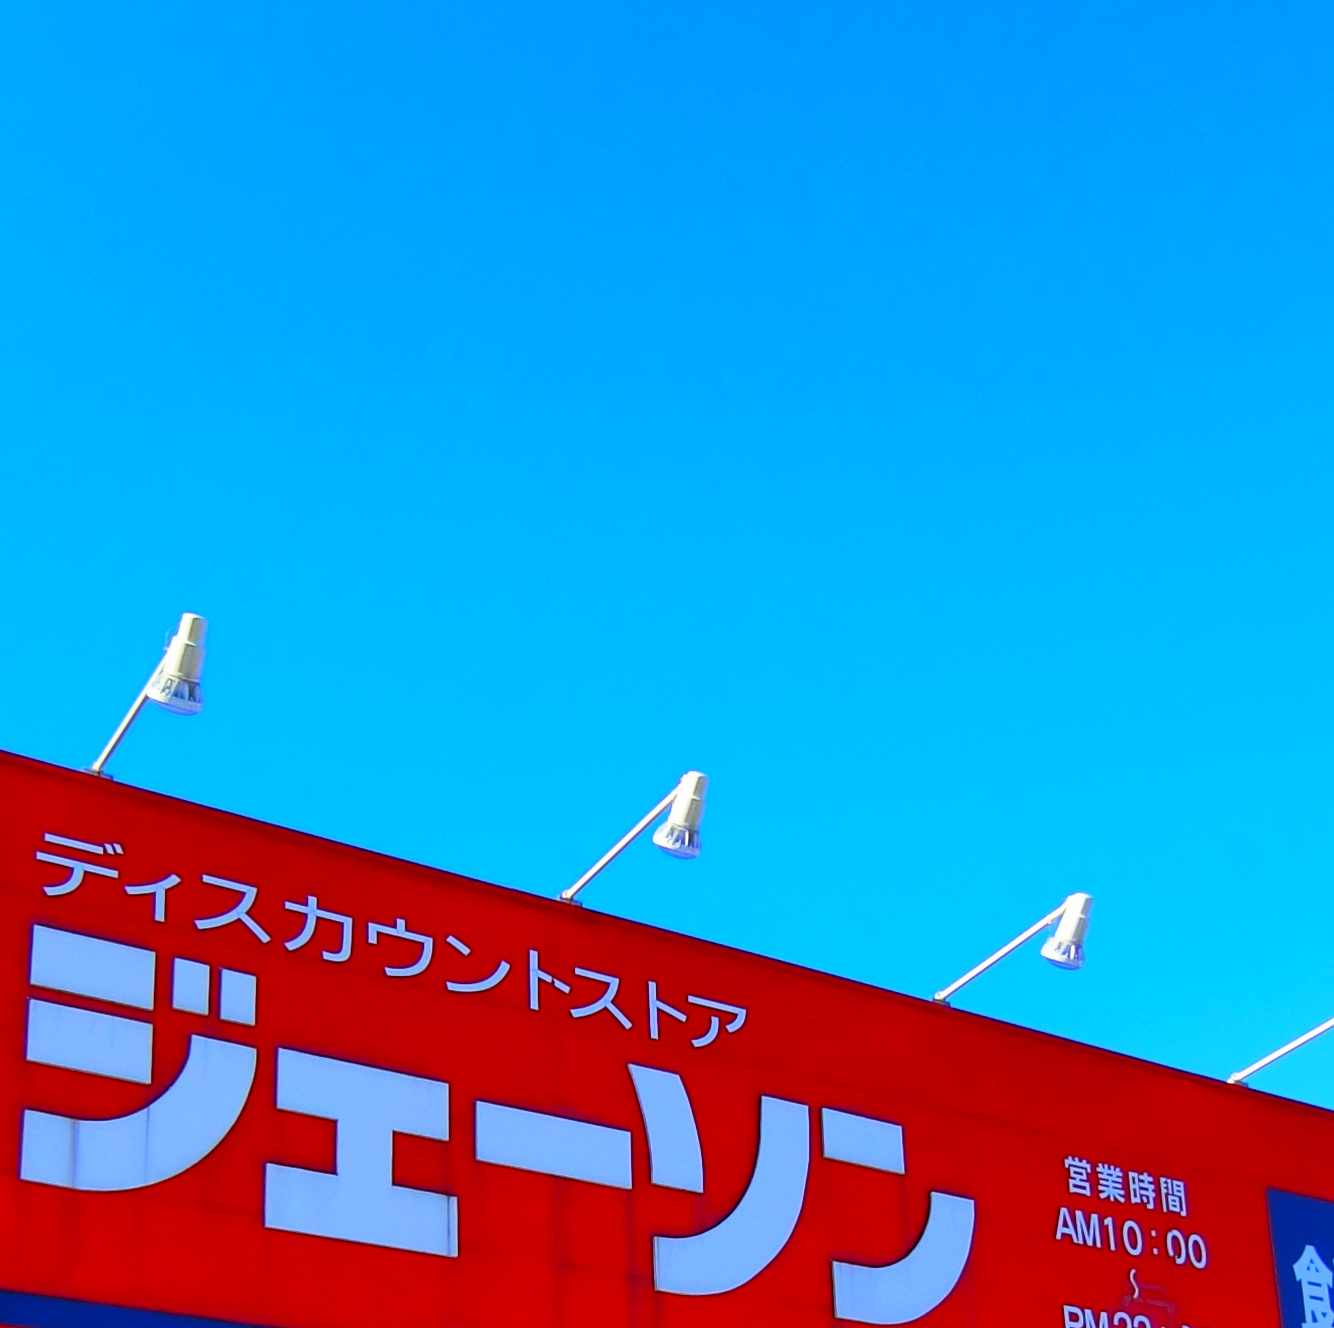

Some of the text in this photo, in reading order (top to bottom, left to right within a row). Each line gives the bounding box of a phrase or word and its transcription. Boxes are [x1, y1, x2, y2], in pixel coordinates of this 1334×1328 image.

[36, 832, 748, 1049] ディスカウントストア
[20, 923, 975, 1325] ジェーソン
[1064, 1156, 1187, 1217] 営業時間
